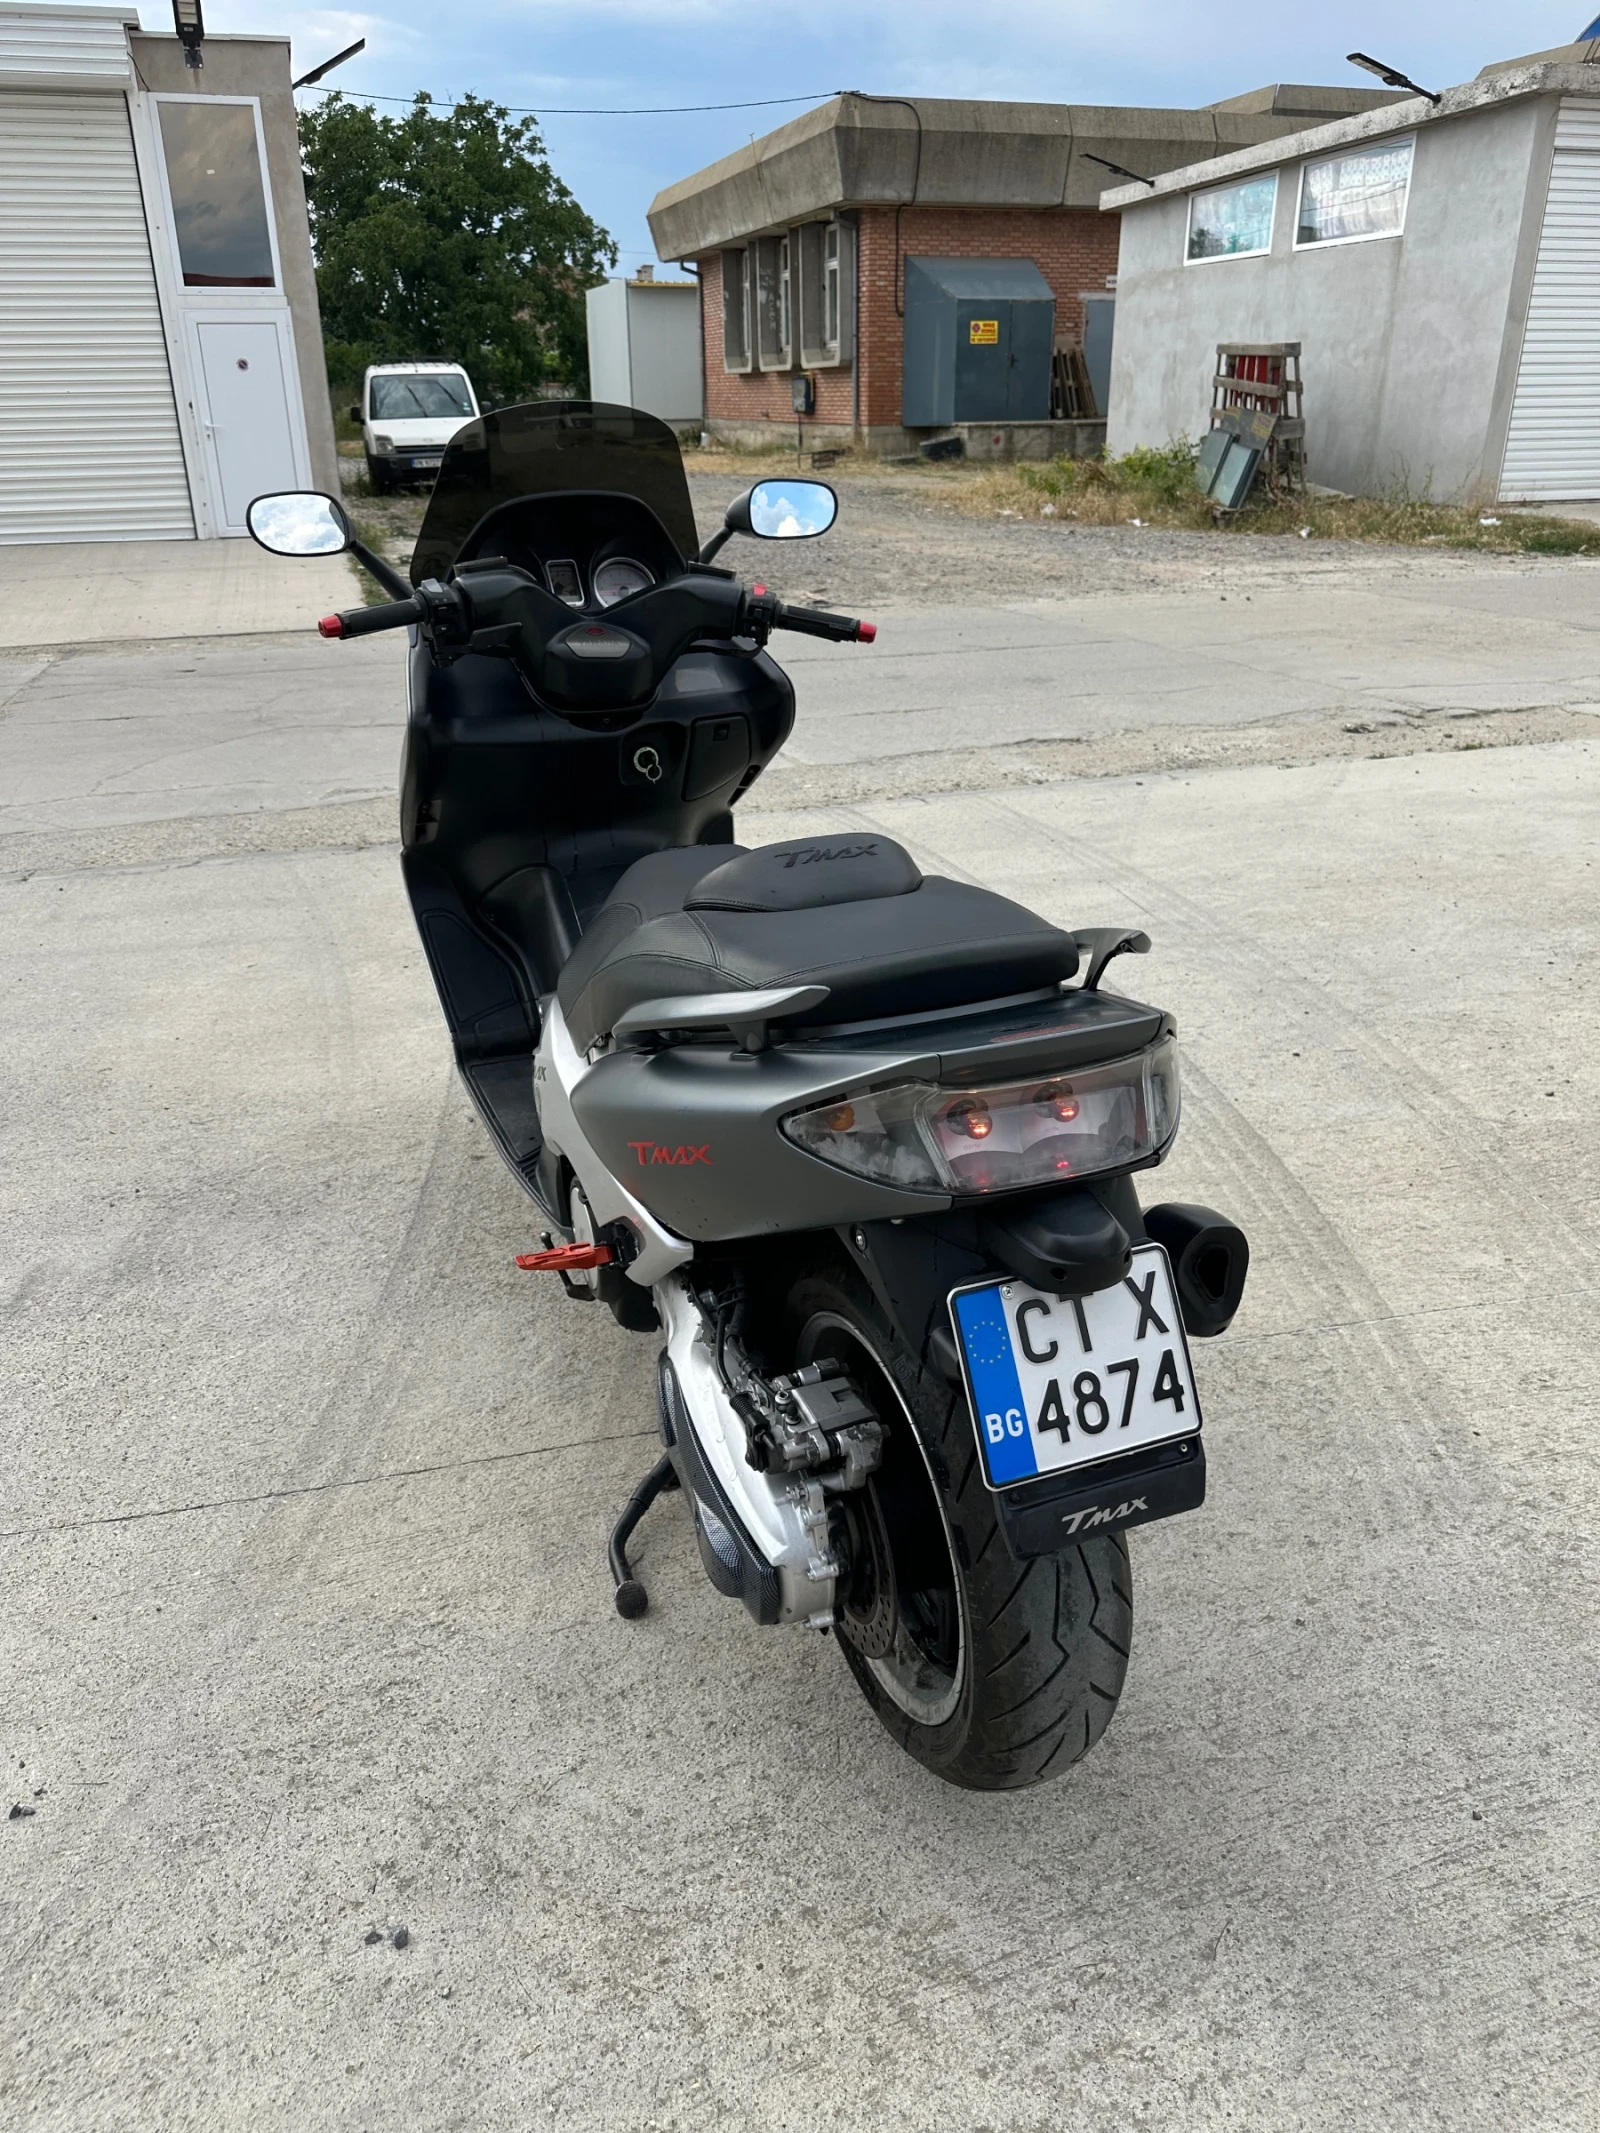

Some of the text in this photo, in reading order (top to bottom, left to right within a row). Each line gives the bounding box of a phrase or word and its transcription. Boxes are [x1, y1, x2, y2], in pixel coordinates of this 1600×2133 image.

[627, 1141, 714, 1166] TMAX
[1015, 1270, 1170, 1364] CT X
[1036, 1348, 1185, 1444] 4874
[984, 1408, 1024, 1443] BG
[1061, 1496, 1149, 1535] TMAX
